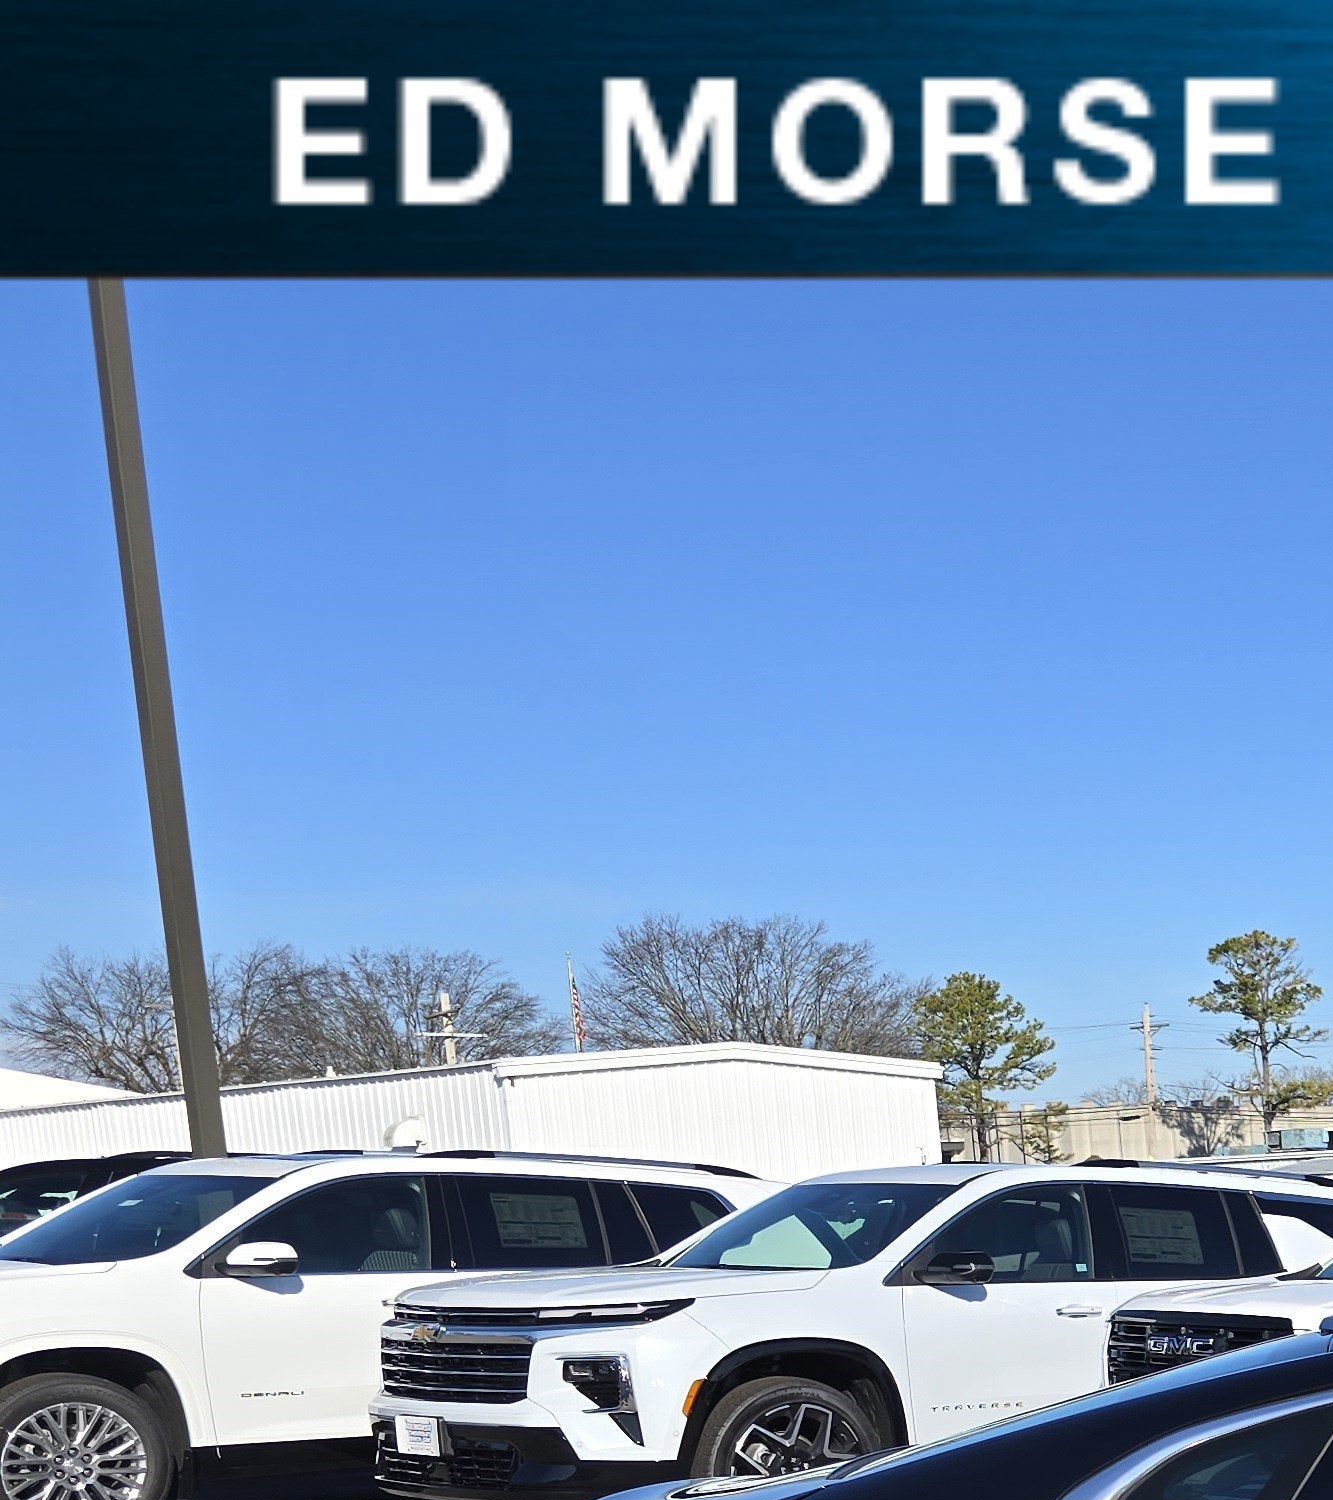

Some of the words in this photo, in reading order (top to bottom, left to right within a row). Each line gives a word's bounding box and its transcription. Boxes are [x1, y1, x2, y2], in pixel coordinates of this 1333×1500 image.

[1148, 1336, 1214, 1356] GMC
[241, 1390, 304, 1398] DENALI
[930, 1402, 1024, 1412] TRAVERSE
